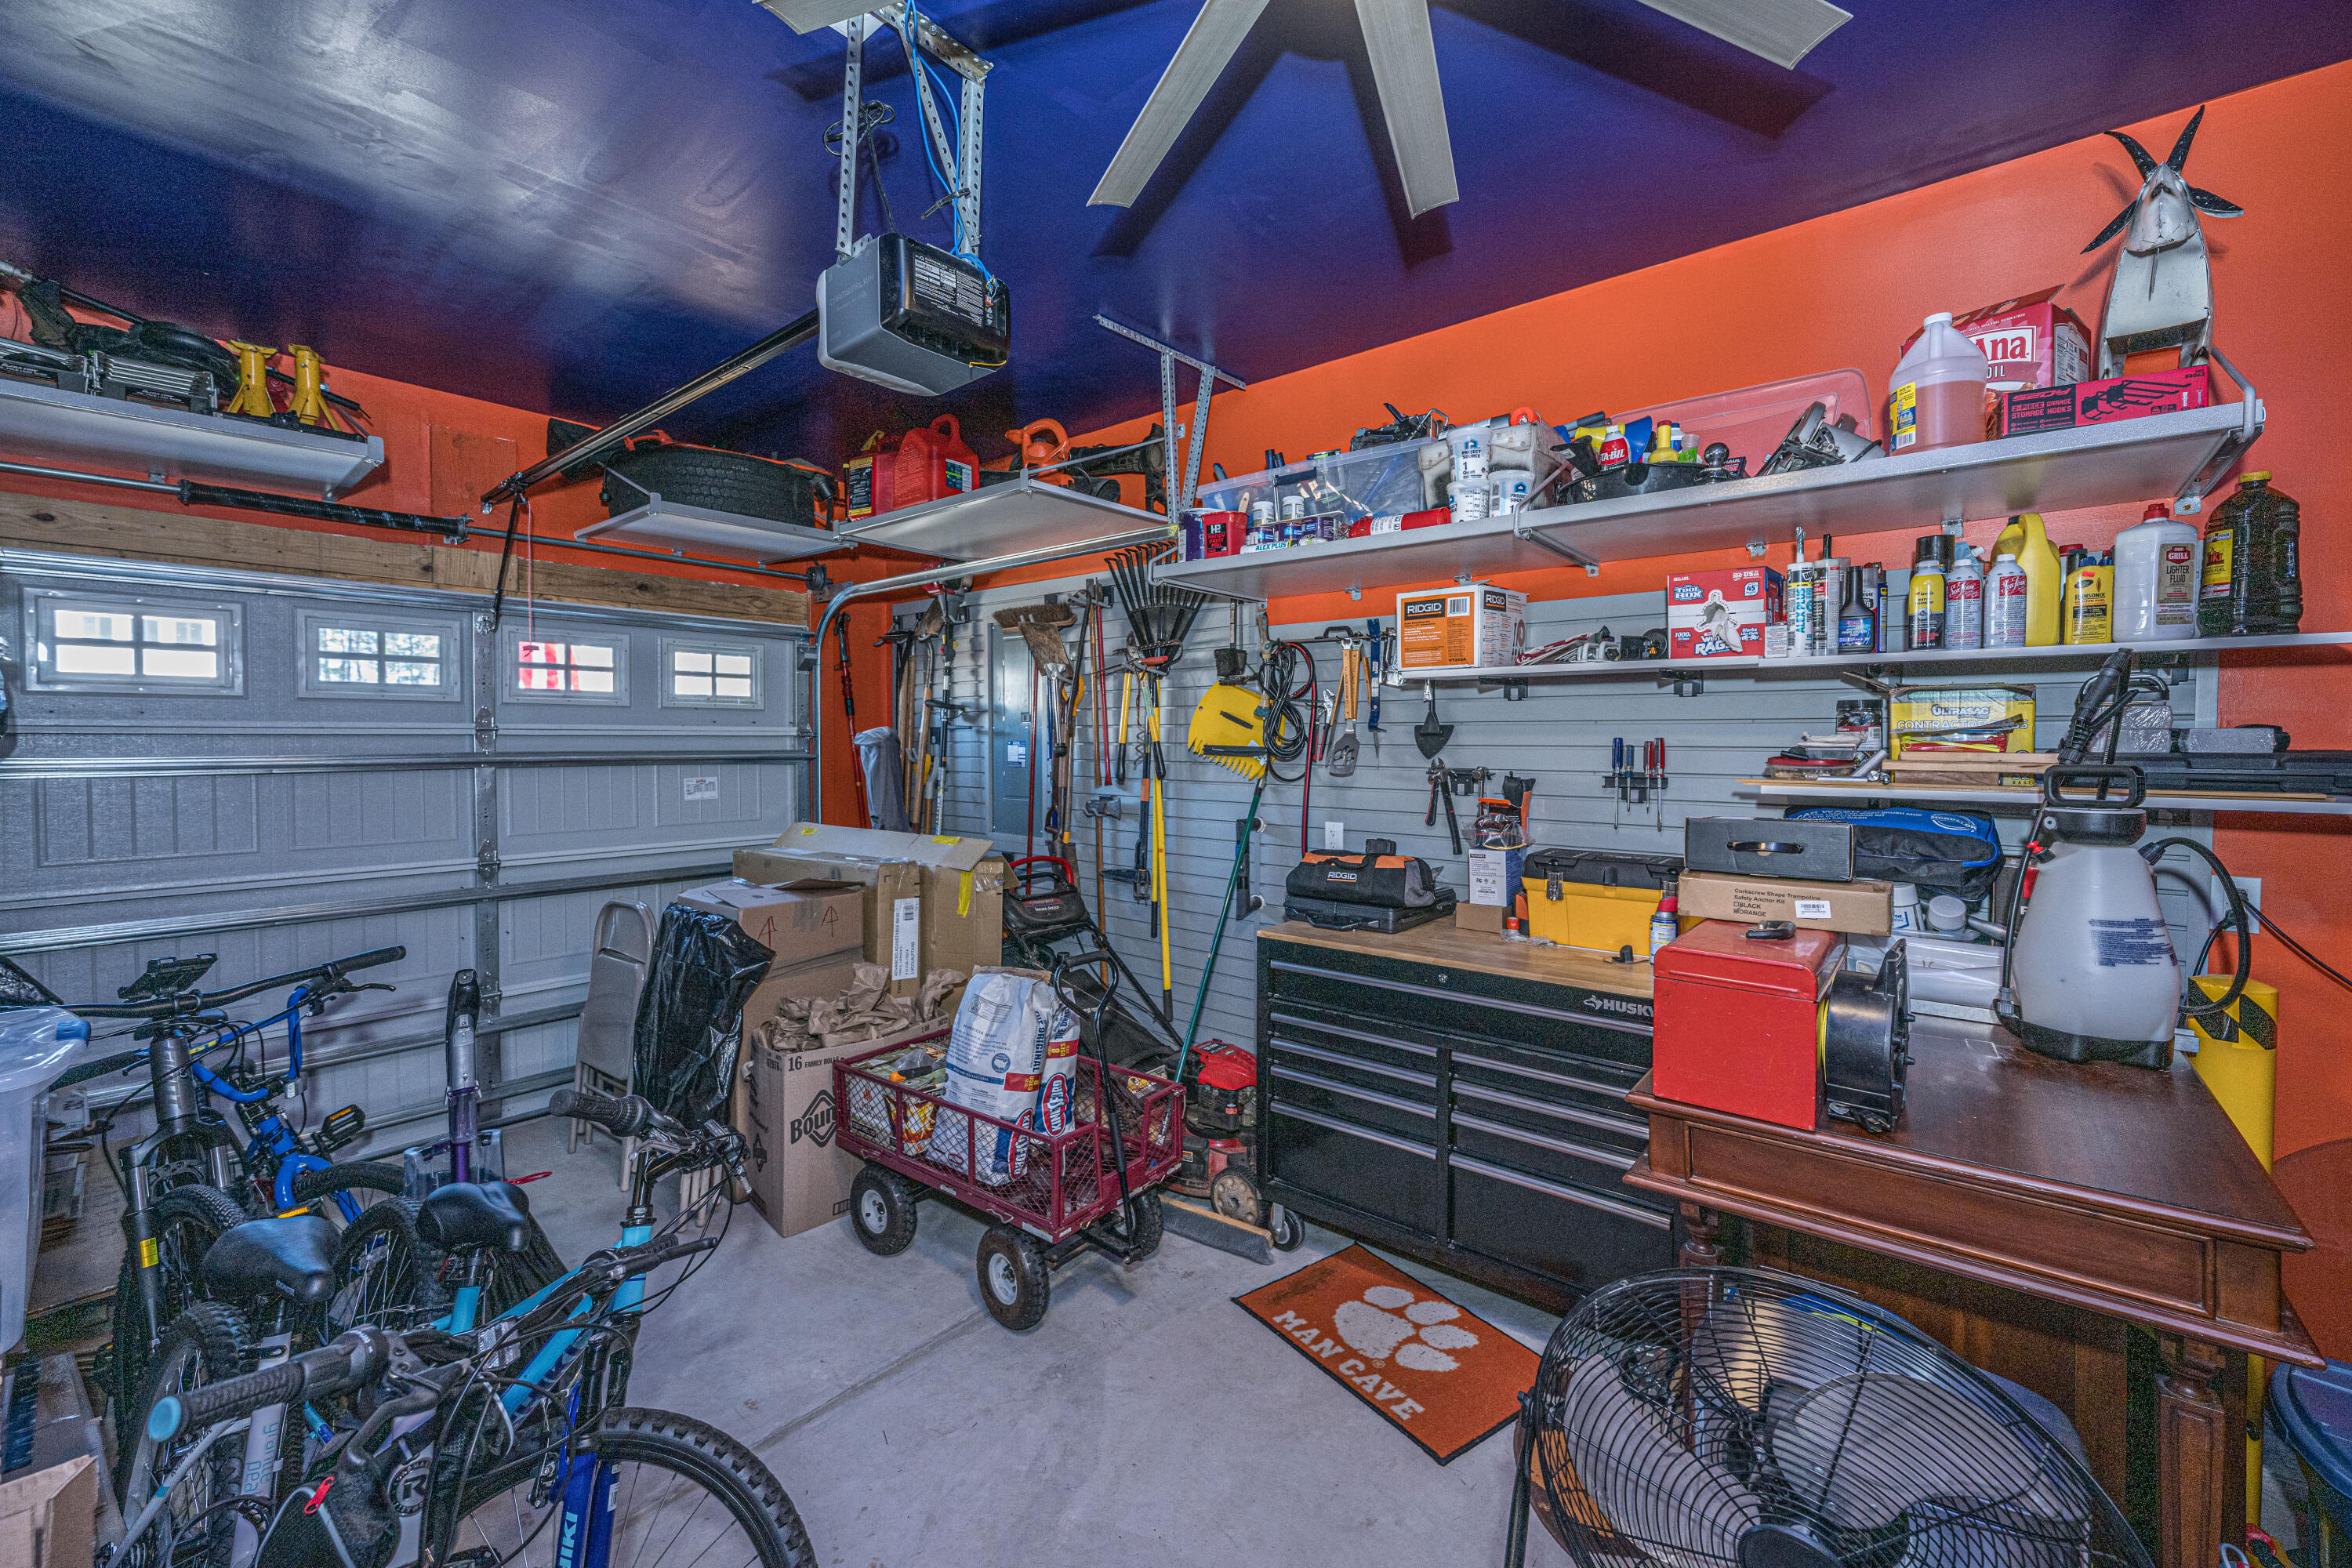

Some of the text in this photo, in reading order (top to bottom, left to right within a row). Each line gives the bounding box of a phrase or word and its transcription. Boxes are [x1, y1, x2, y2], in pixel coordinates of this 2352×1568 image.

[2046, 398, 2071, 407] GARAGE
[2012, 405, 2072, 419] STORAGE HOOKS
[1255, 543, 1271, 551] ALEX
[2166, 565, 2190, 575] LIGHTER
[2169, 575, 2186, 583] FLUID
[1486, 594, 1506, 605] RIDGID
[1407, 602, 1443, 614] RIDGID
[1795, 587, 1806, 633] ALEX PLUS
[1694, 639, 1730, 656] RAG
[1930, 704, 1990, 717] ULTRASAC
[1327, 871, 1358, 880] RIDGID
[1032, 1026, 1046, 1073] ORIGINAL
[788, 1055, 803, 1072] 16
[804, 1059, 823, 1069] FAMILY
[1047, 1078, 1065, 1133] KINGSFORD
[790, 1105, 837, 1145] Boun
[1272, 1309, 1425, 1421] MAN CAVE
[260, 1422, 280, 1484] granite
[245, 1461, 263, 1496] pea
